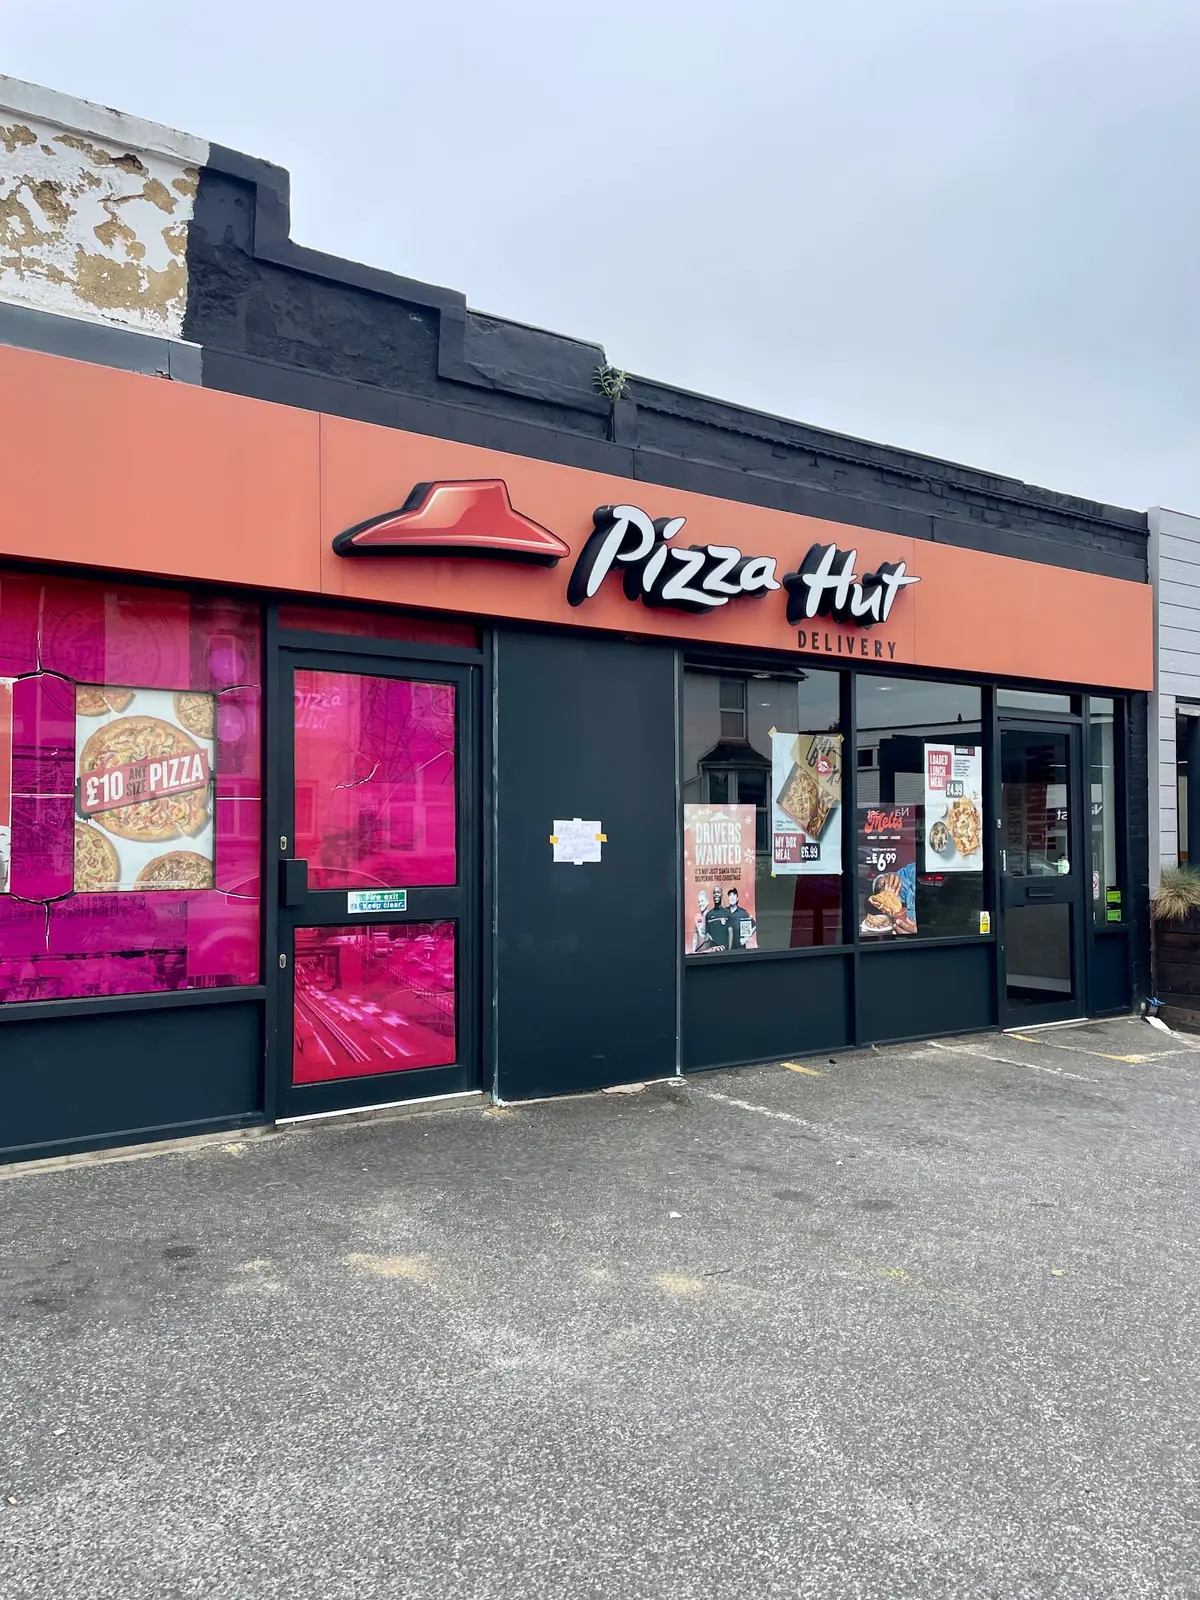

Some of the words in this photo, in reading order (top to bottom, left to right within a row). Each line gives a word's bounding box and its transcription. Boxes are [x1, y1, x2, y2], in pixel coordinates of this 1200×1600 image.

[571, 503, 782, 611] Pizza
[787, 542, 922, 628] Hut
[797, 629, 897, 660] DELIVERY
[929, 754, 949, 766] LOADED
[128, 765, 147, 781] ANY
[149, 754, 205, 792] PIZZA
[86, 771, 124, 806] £10
[126, 779, 147, 797] SIZE
[930, 776, 944, 788] MEAL
[864, 810, 903, 834] Melts
[695, 822, 742, 843] DRIVERS
[775, 836, 785, 848] MY
[785, 836, 797, 848] BOX
[695, 844, 742, 866] WANTED
[775, 848, 791, 861] MEAL
[800, 846, 818, 859] £6.99
[365, 893, 382, 901] Fire
[383, 892, 399, 901] exit
[362, 902, 381, 910] Keep
